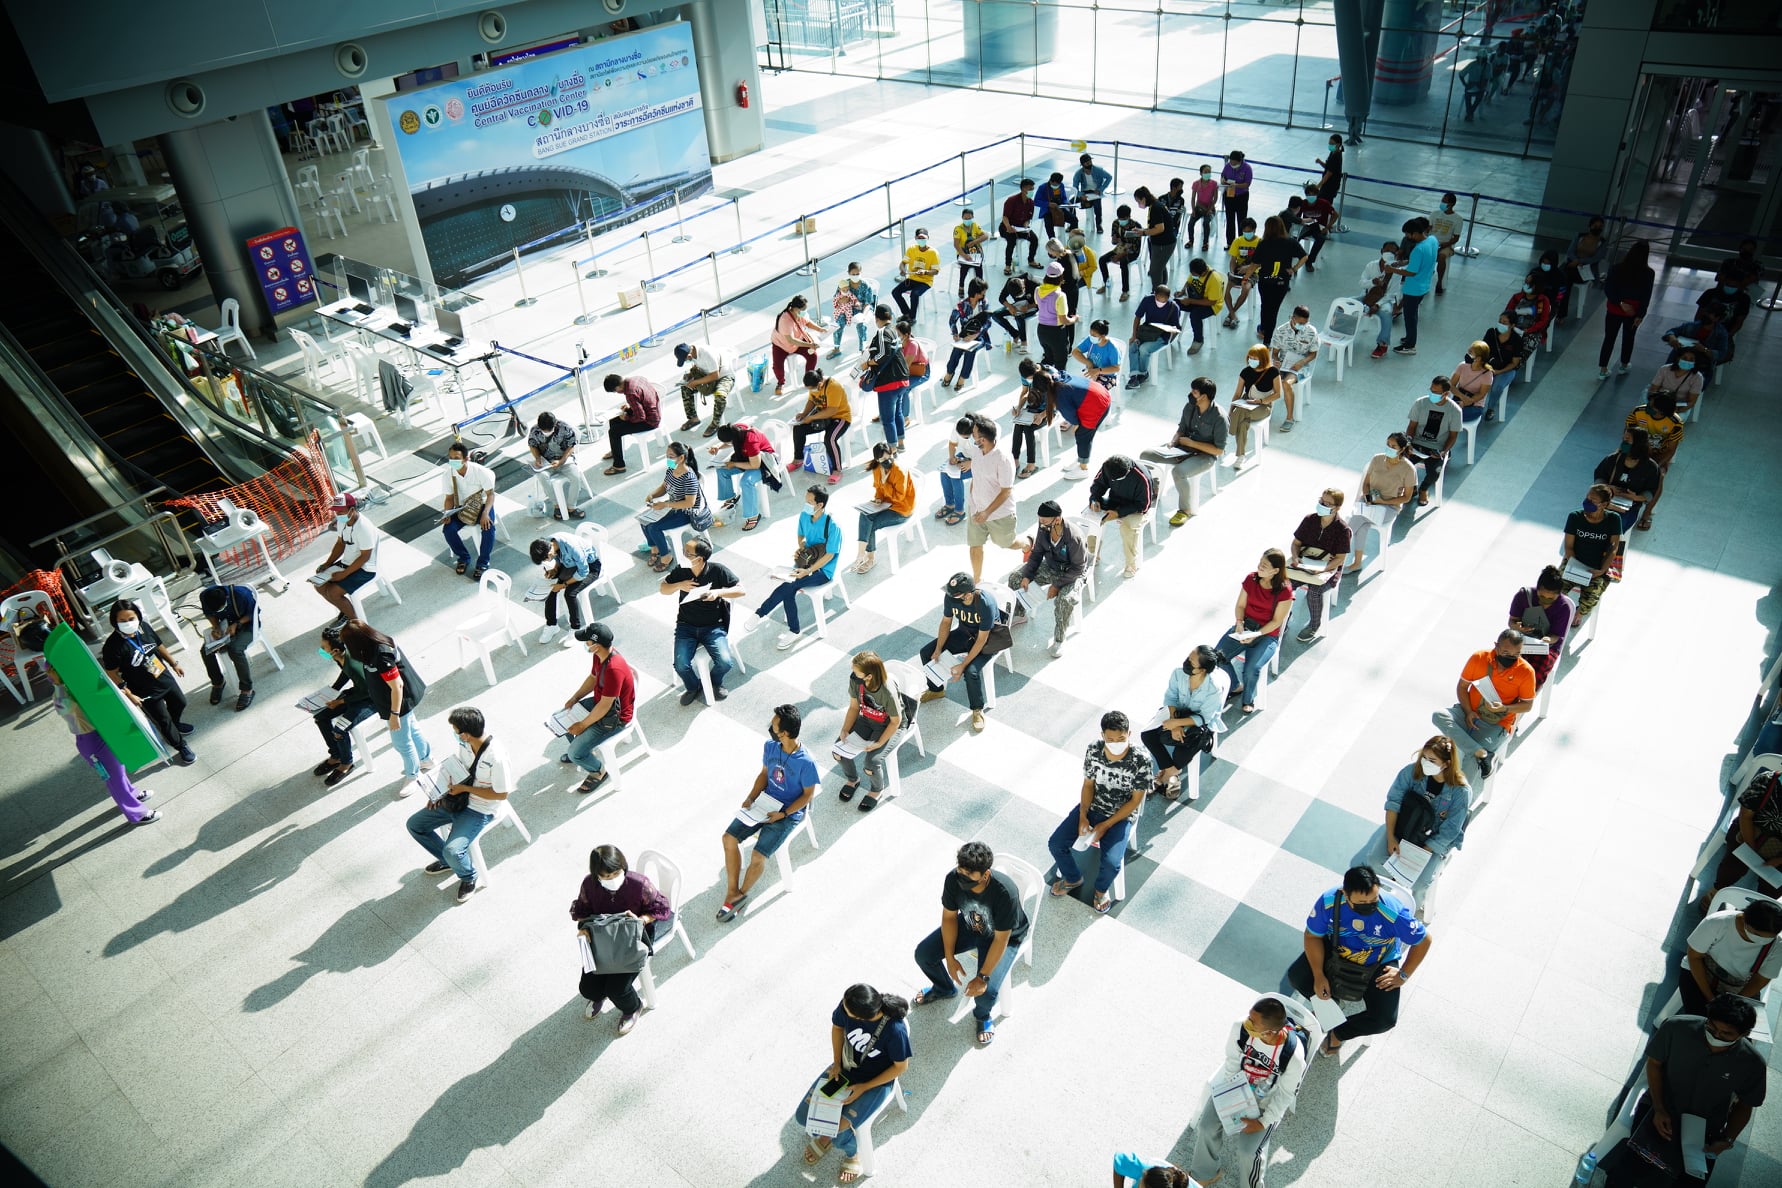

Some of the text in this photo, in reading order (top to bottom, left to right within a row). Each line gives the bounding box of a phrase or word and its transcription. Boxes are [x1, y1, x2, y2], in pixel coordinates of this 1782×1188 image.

[595, 48, 642, 70] สถานีกลางบางซื่อ
[467, 79, 512, 98] ยินดีต้อนรับ
[471, 71, 585, 116] ศูนย์ฉีดวัคซีนกลาง บางซื่อ
[474, 89, 586, 128] Central Vaccination Center
[535, 110, 611, 147] สถานีกลางบางซื่อ
[537, 126, 612, 155] BANG SUE GRAND STATION
[952, 607, 981, 624] POLO
